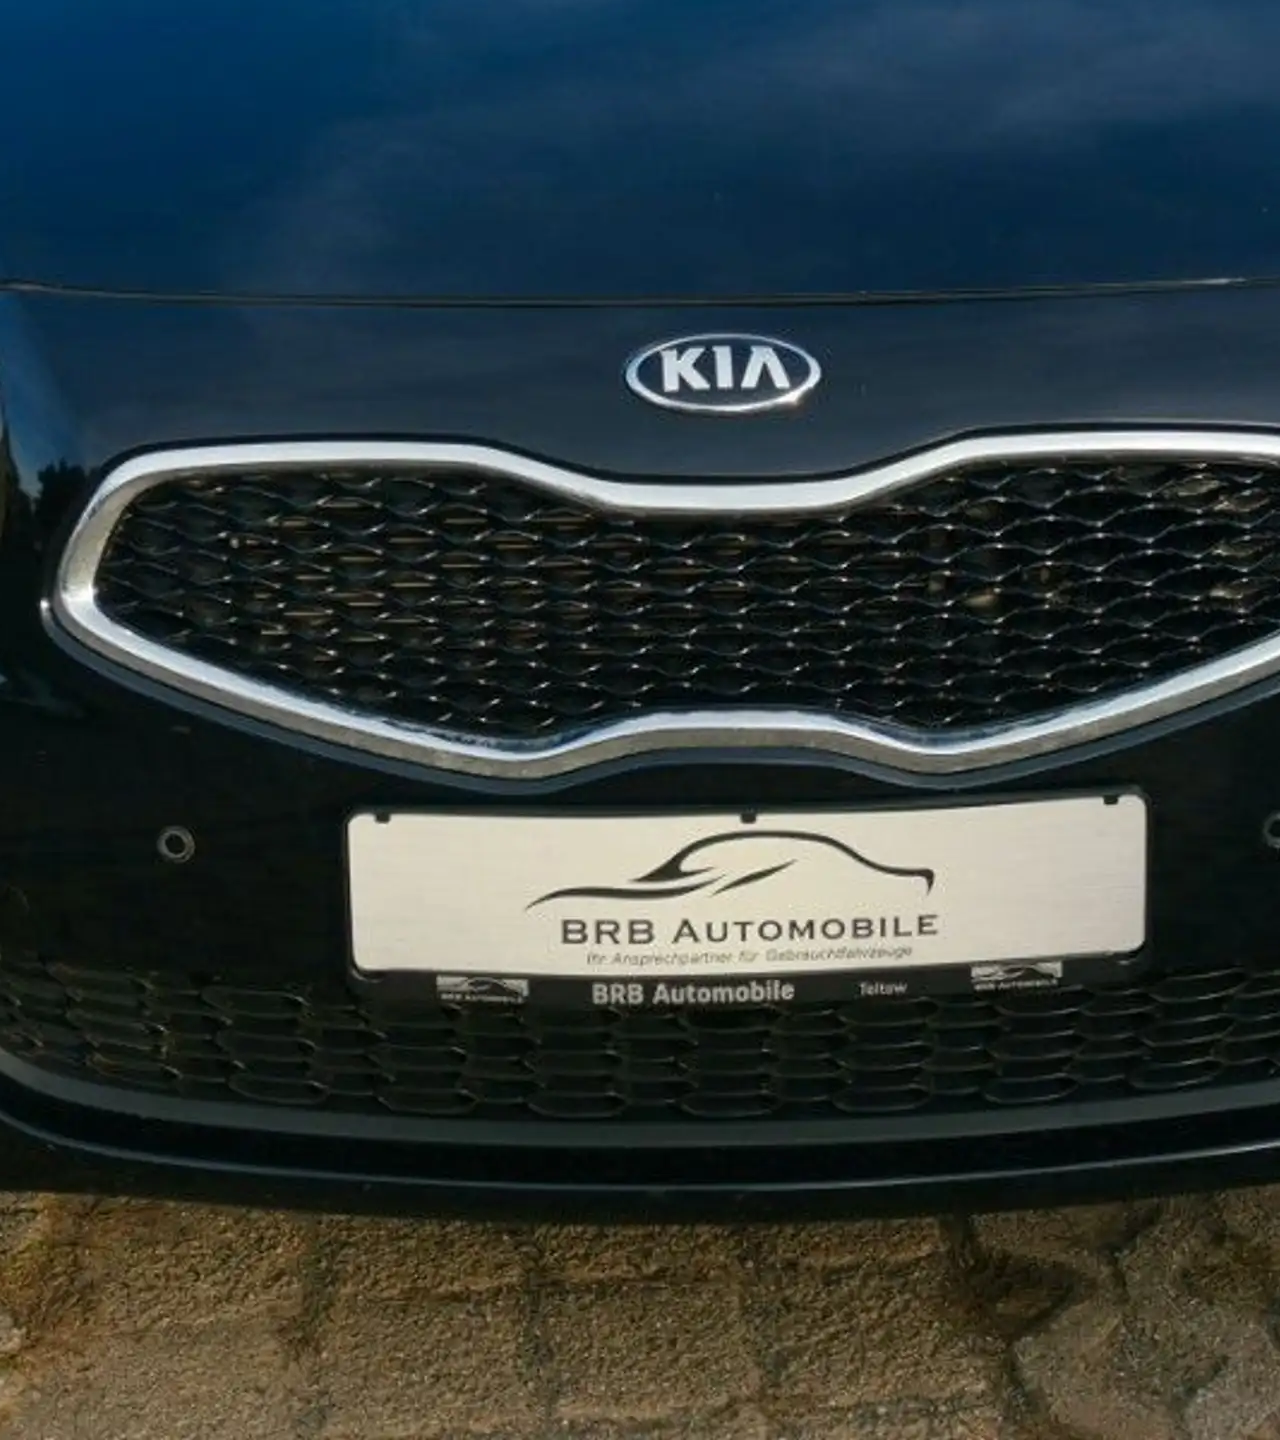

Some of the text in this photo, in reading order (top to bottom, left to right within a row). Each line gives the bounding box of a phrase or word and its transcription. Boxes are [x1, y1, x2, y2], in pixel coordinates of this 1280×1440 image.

[659, 344, 791, 393] KIA
[560, 913, 939, 945] BRB AUTOMOBILE
[591, 979, 796, 1006] BRB Automobile
